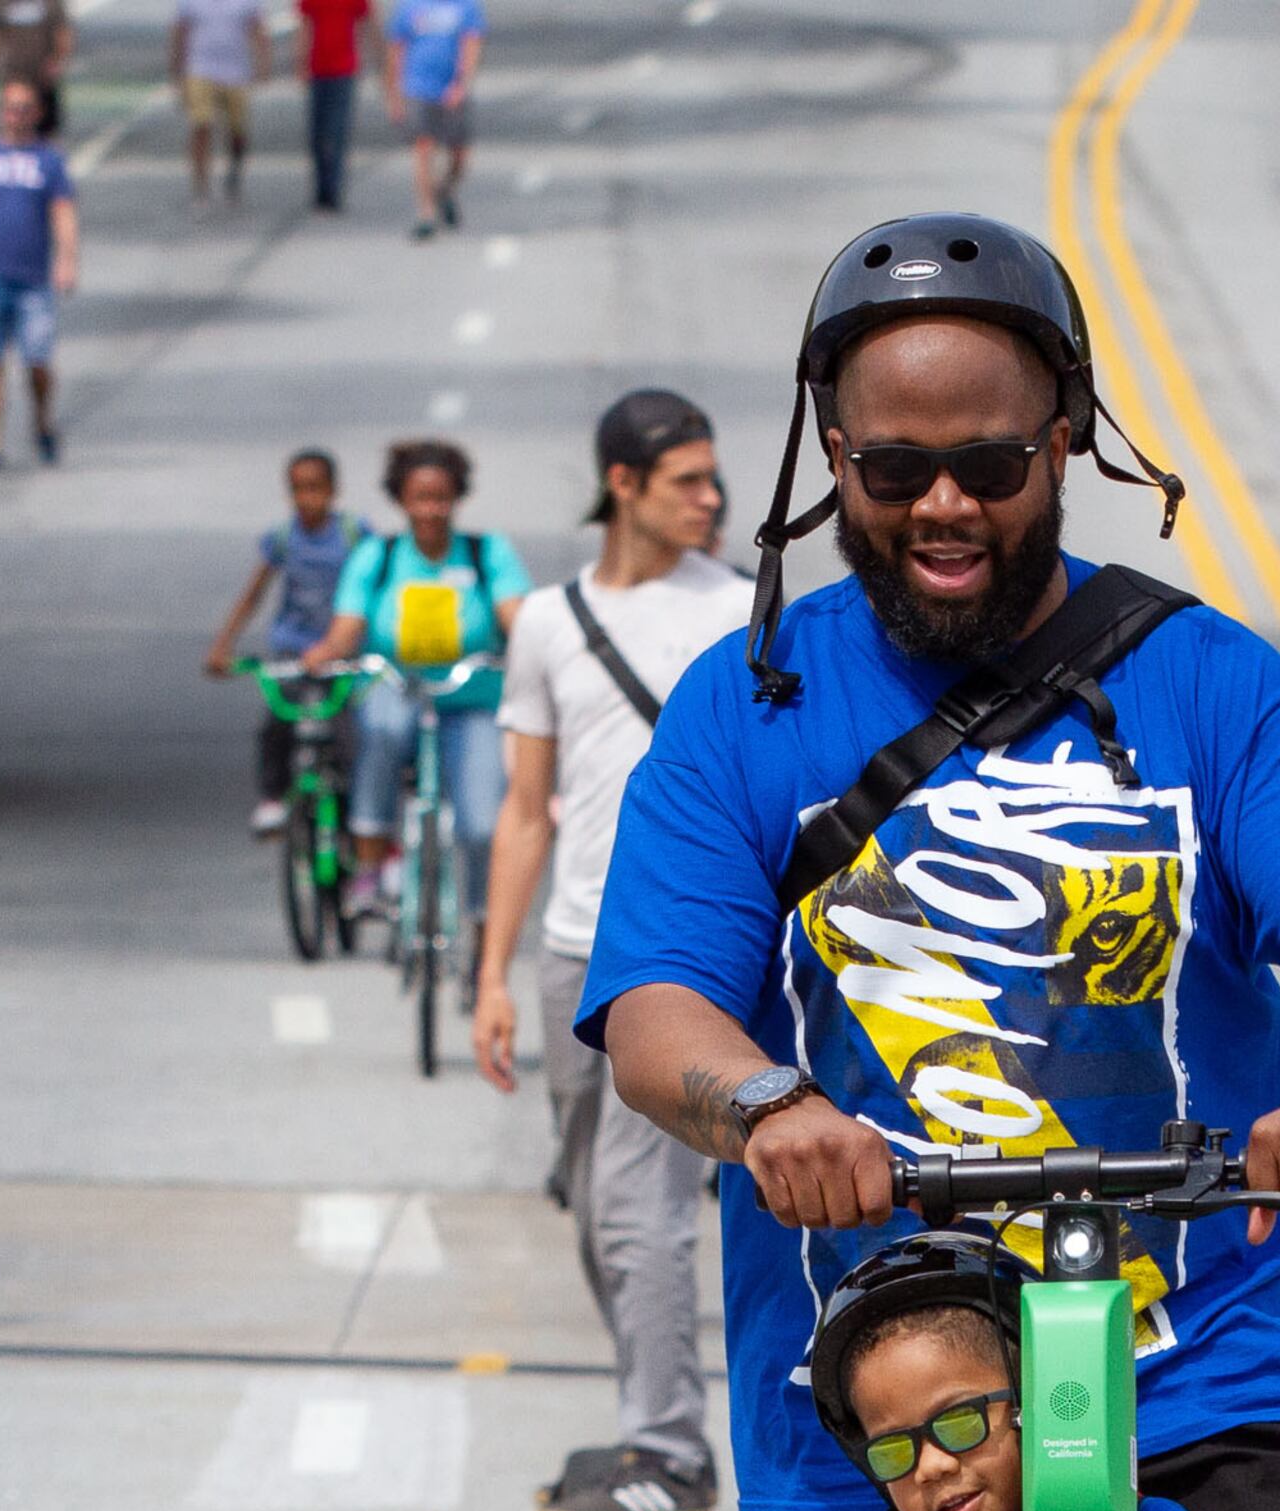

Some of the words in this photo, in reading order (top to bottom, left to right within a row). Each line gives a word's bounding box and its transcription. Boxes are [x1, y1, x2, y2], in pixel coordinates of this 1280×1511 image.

[1042, 1438, 1087, 1449] Designed
[1087, 1437, 1098, 1447] in
[1047, 1449, 1093, 1458] California
